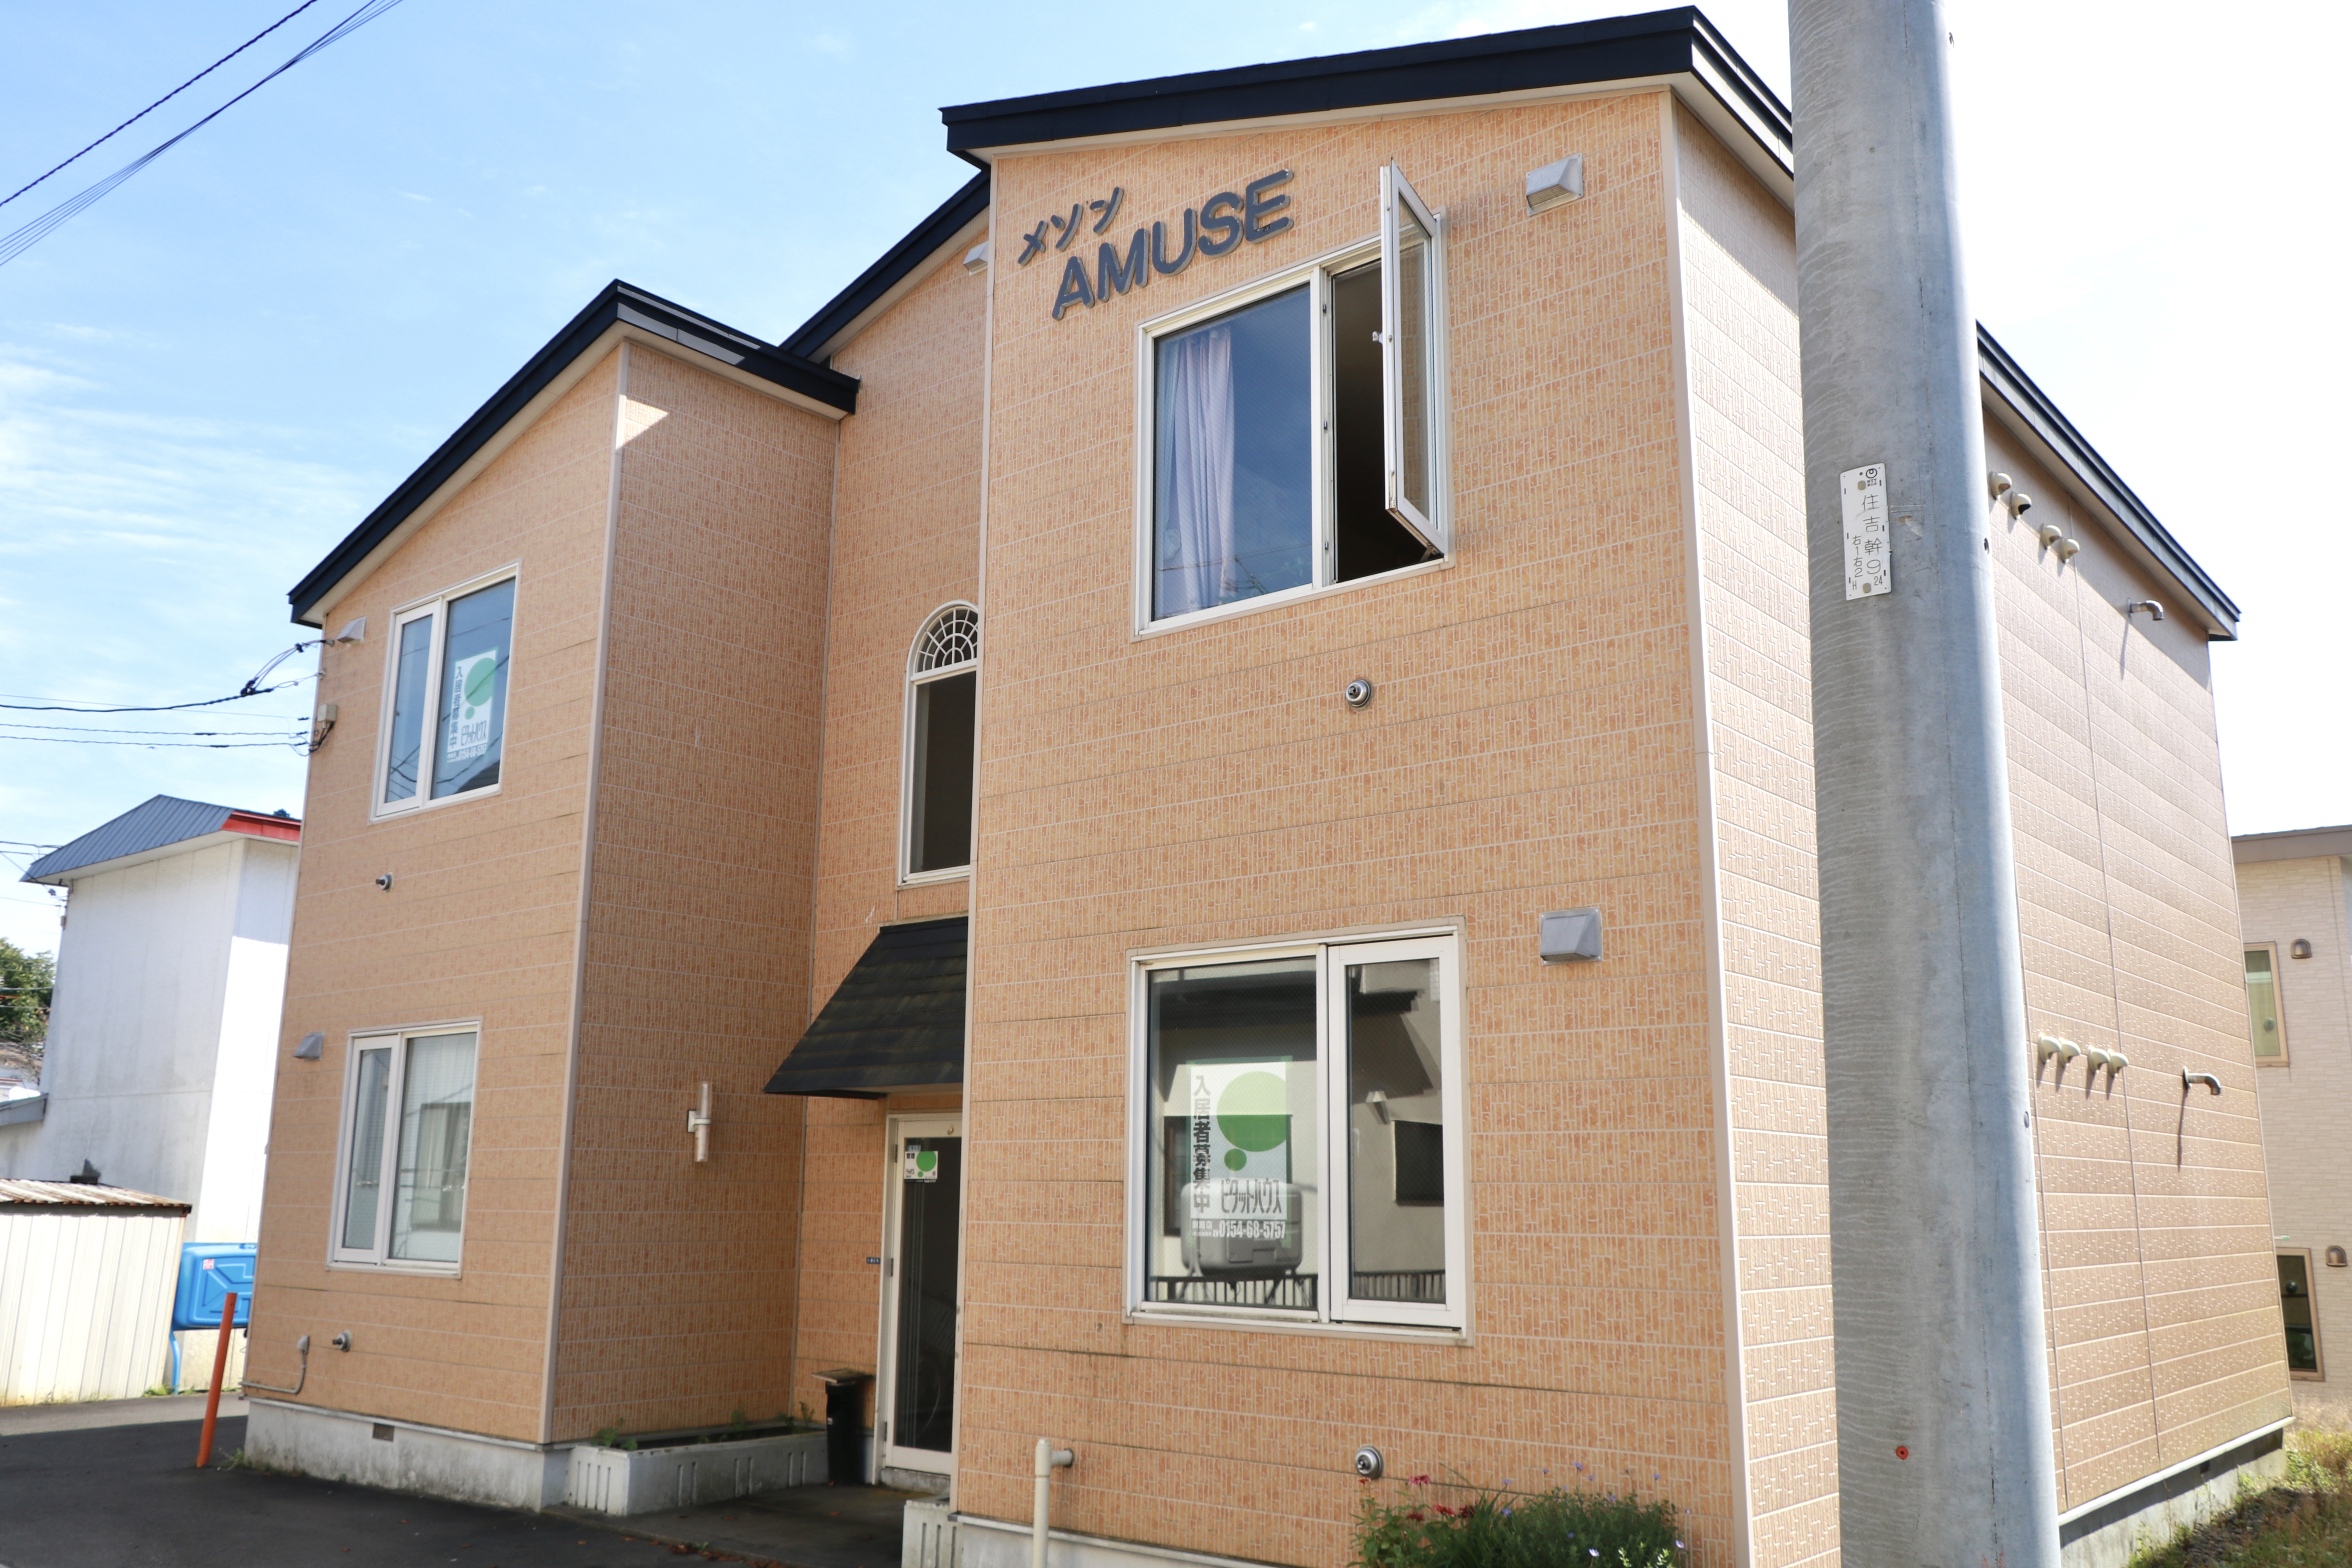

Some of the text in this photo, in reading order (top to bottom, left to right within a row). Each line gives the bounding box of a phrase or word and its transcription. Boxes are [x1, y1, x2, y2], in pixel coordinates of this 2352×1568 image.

[1052, 168, 1294, 321] AMUSE
[1852, 575, 1883, 590] H 24
[450, 666, 463, 749] 入居者募集中
[461, 720, 486, 746] ピタットハウス
[1193, 1075, 1211, 1213] 入居者募集中
[1221, 1178, 1282, 1214] ピタットハウス
[1219, 1220, 1286, 1239] 0154-68-5757
